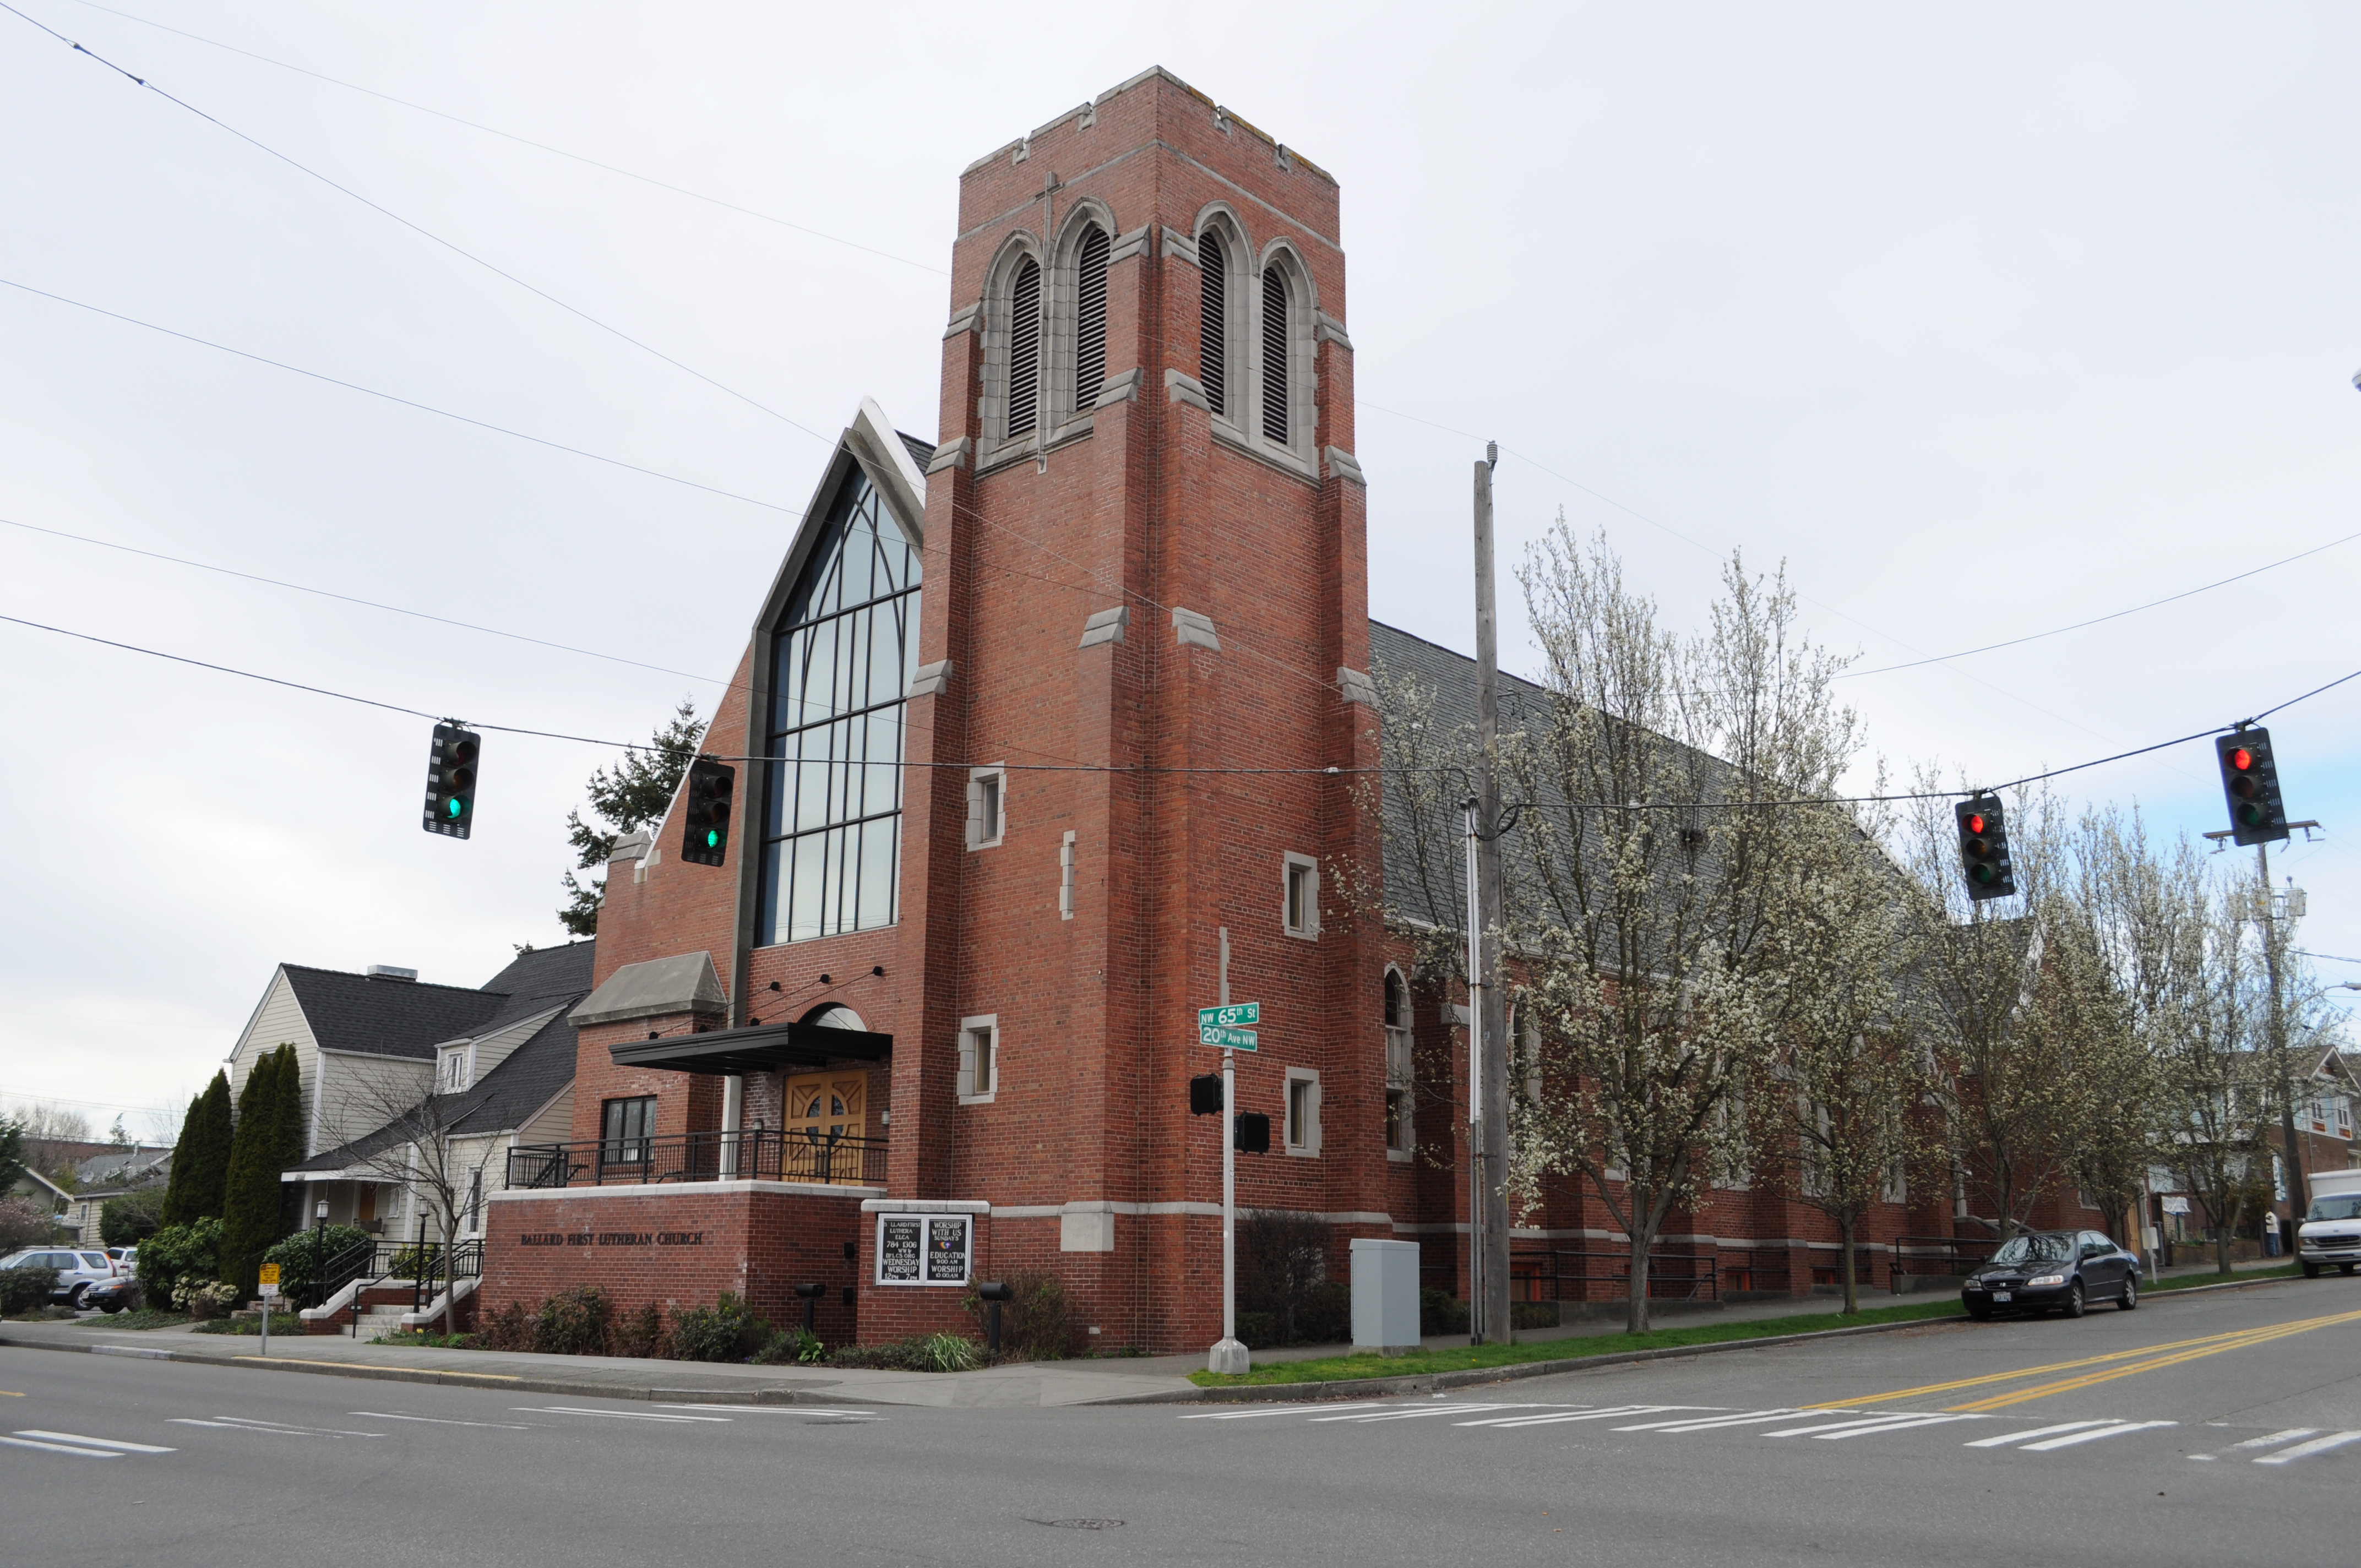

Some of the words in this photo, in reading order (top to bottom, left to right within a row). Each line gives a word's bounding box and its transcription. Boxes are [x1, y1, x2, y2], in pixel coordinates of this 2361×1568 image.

[1201, 1012, 1214, 1023] NW
[1218, 1007, 1243, 1024] 65th
[1247, 1008, 1256, 1019] St
[1203, 1027, 1226, 1043] 20th
[1227, 1033, 1241, 1044] Ave
[1243, 1035, 1255, 1046] NW
[521, 1234, 563, 1245] BALLARD
[567, 1233, 594, 1245] FIRST
[599, 1233, 652, 1245] LUTHERAN
[657, 1233, 702, 1245] CHURCH
